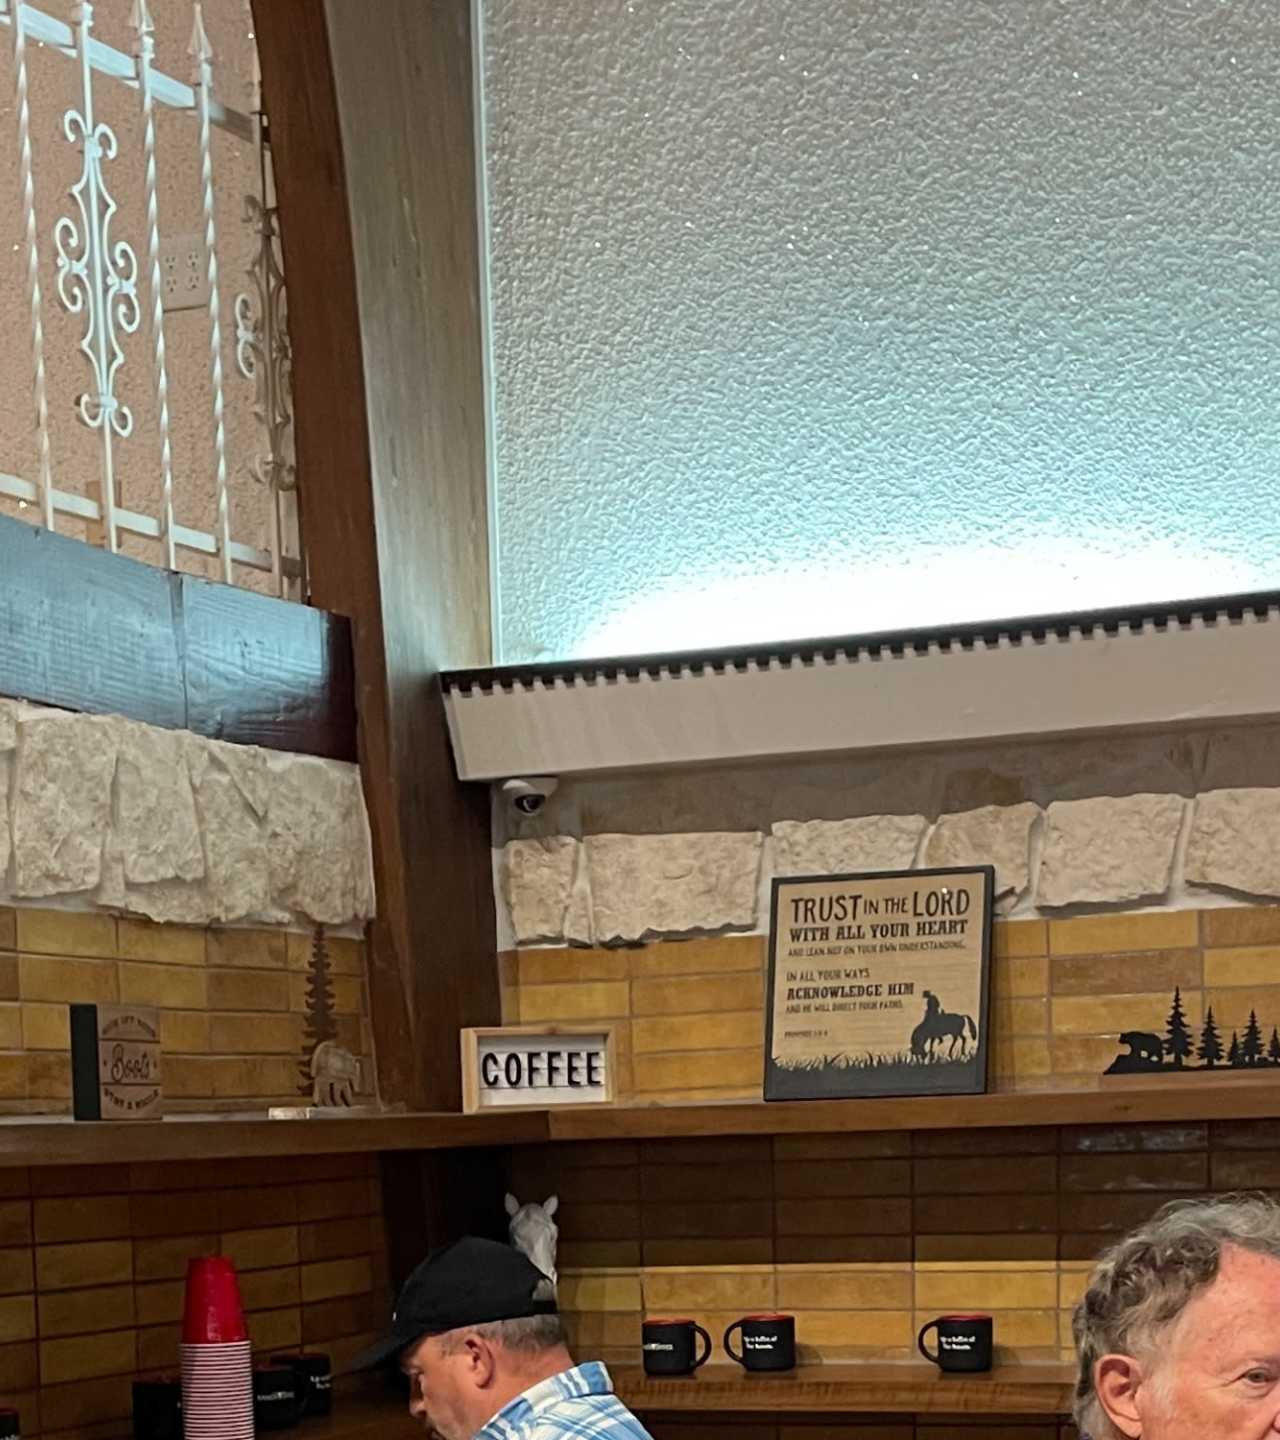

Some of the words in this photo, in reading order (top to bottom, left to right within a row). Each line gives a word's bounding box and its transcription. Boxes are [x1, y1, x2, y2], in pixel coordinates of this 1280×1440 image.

[790, 894, 863, 924] TRUST
[863, 898, 879, 915] IN
[884, 896, 909, 914] THE
[912, 888, 971, 918] LORD
[789, 926, 830, 943] WITH
[835, 925, 866, 941] ALL
[870, 922, 910, 939] YOUR
[916, 919, 969, 937] HEART
[843, 967, 870, 980] WAYS
[786, 983, 883, 1001] ACKNOWLEDGE
[887, 982, 915, 996] HIM
[481, 1051, 602, 1089] COFFEE
